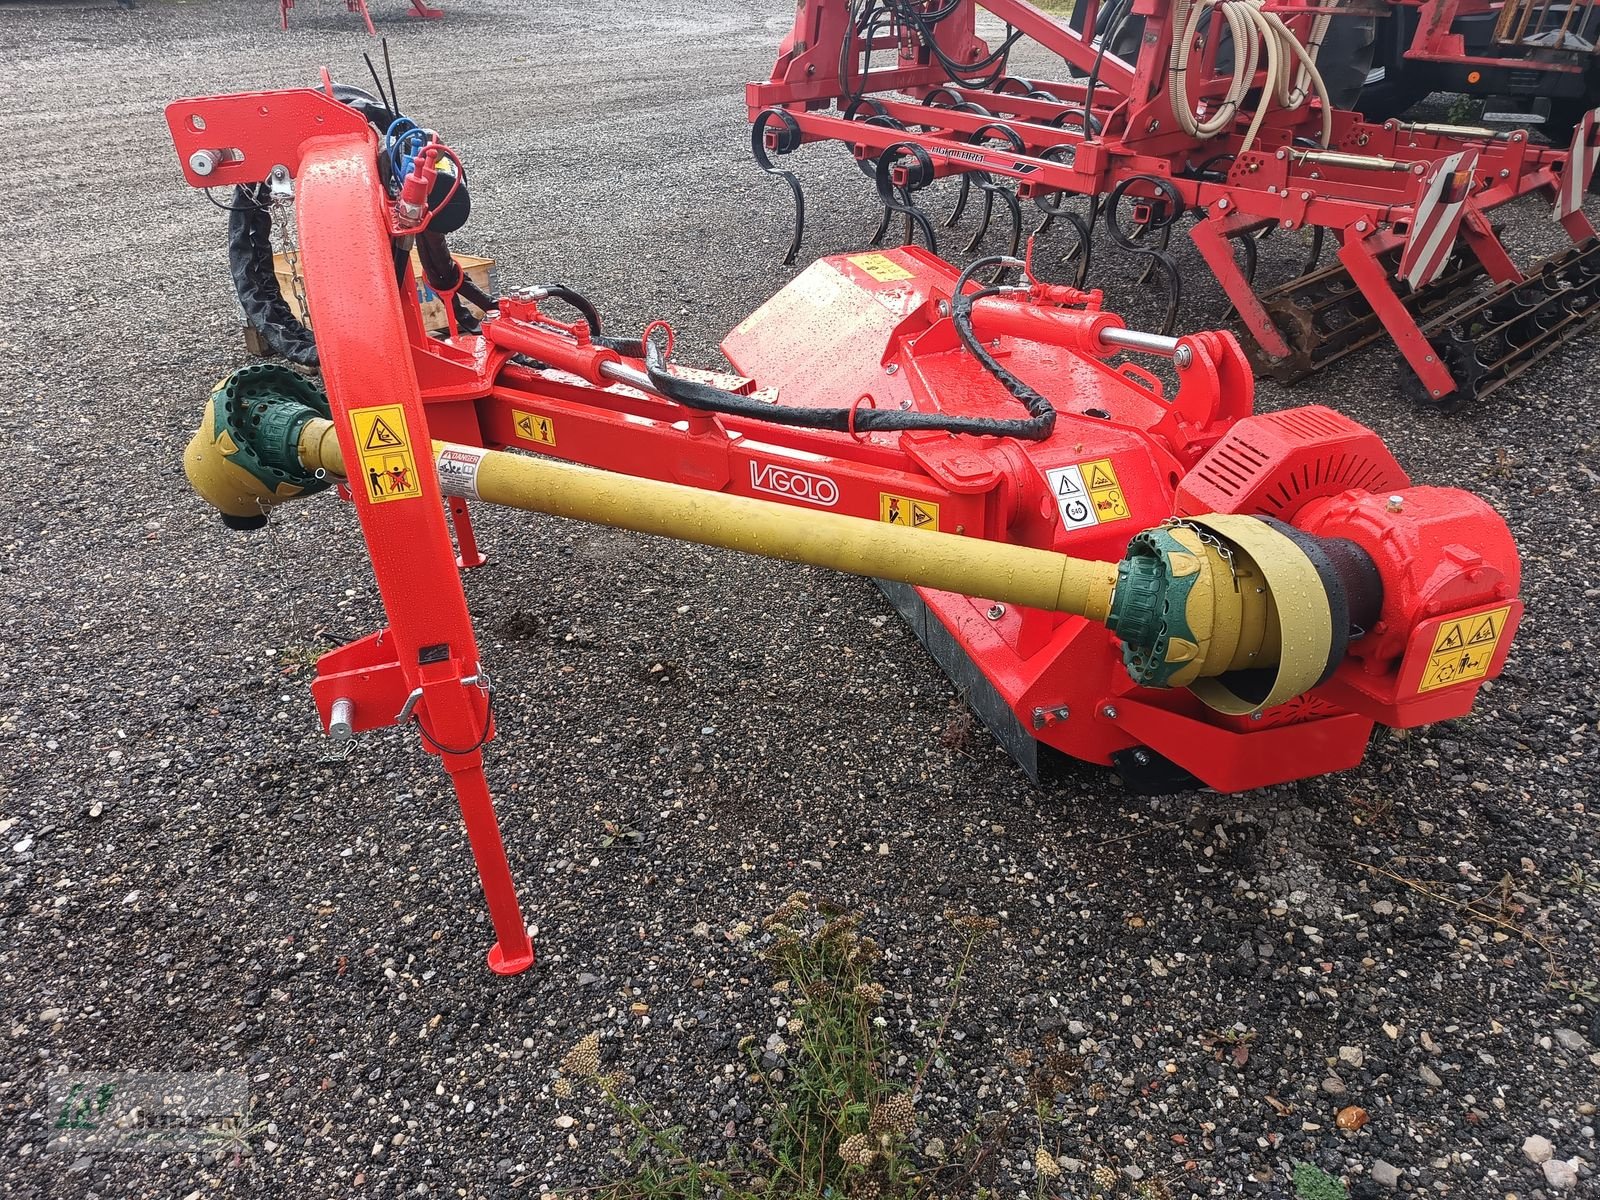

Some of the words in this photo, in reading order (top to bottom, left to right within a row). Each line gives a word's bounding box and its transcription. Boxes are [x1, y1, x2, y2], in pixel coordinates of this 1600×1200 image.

[452, 453, 478, 464] DANGER
[750, 460, 839, 506] VIGOLO
[1071, 507, 1083, 515] 540
